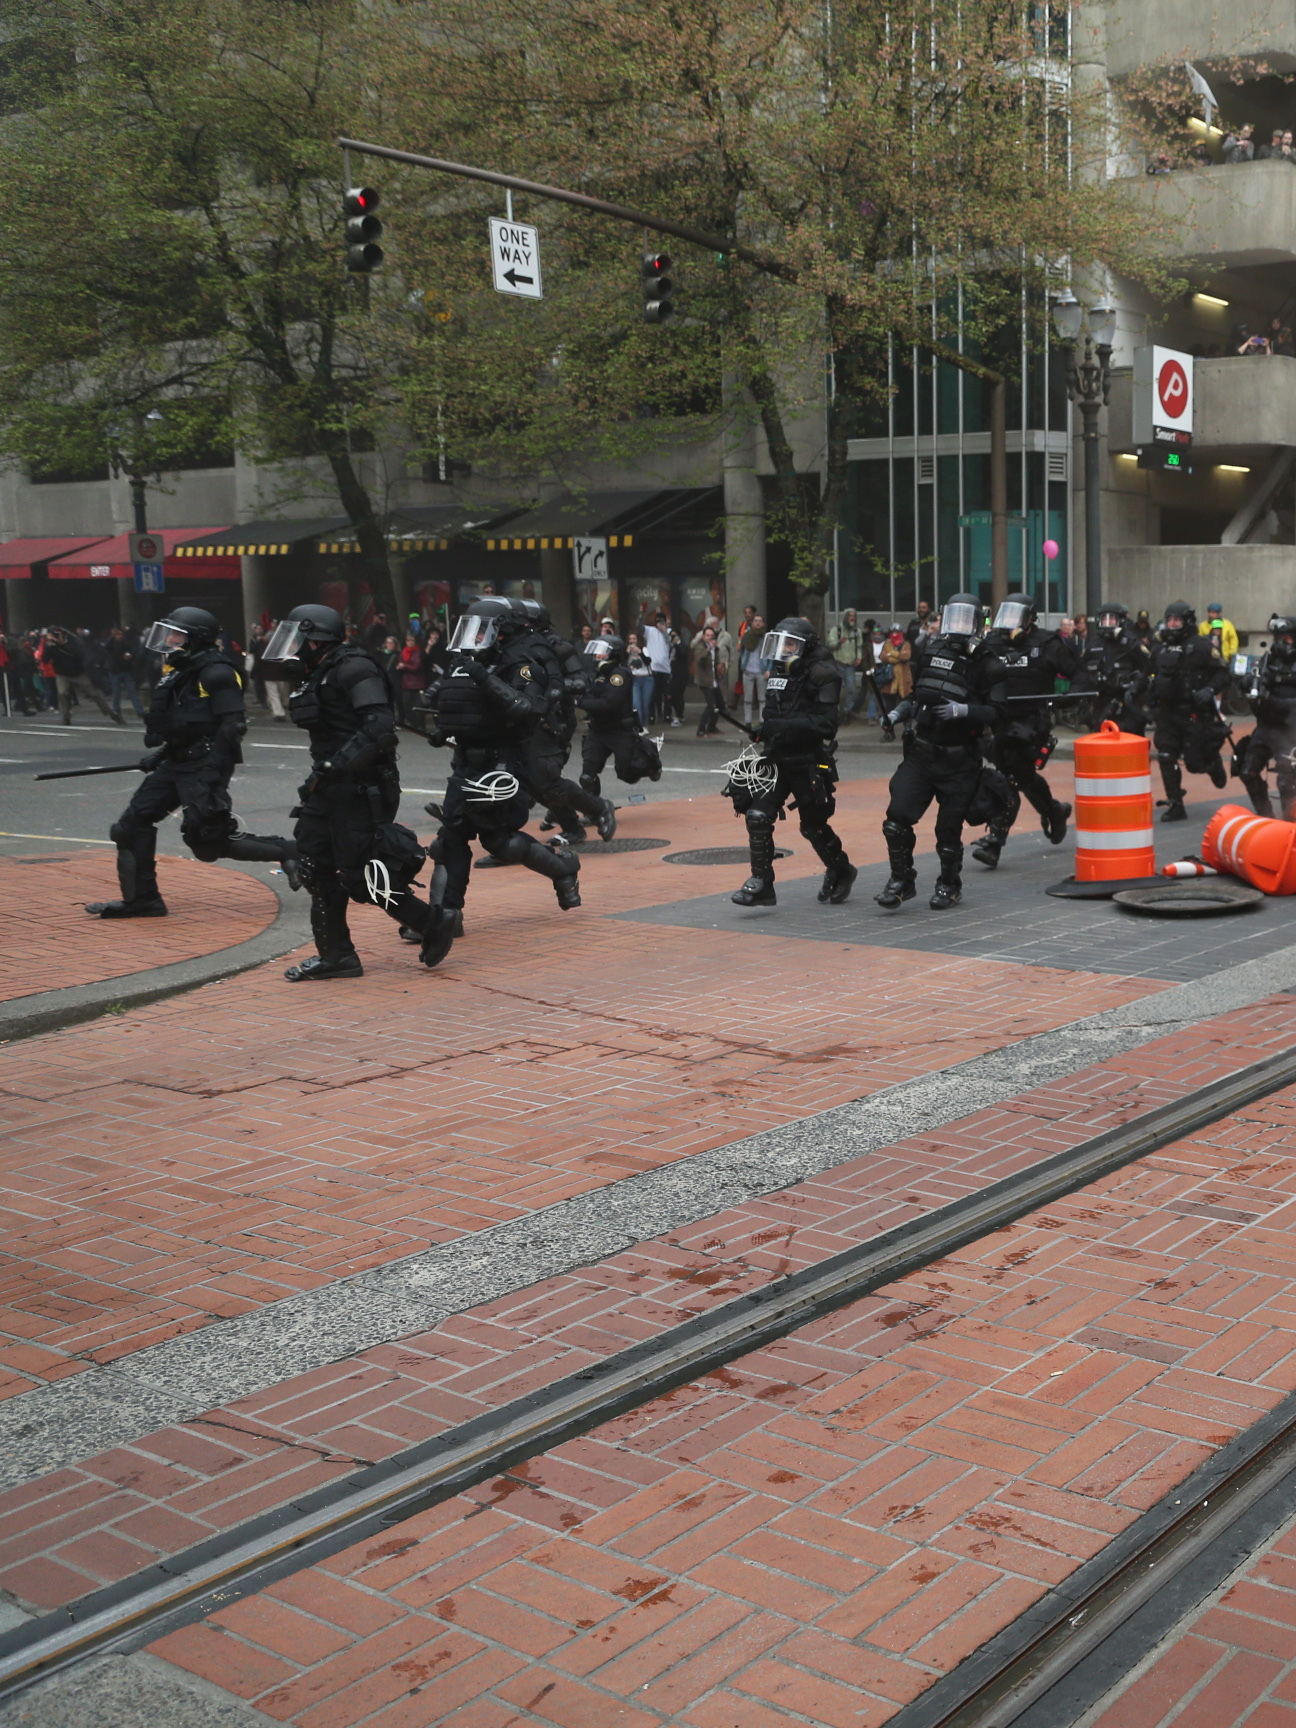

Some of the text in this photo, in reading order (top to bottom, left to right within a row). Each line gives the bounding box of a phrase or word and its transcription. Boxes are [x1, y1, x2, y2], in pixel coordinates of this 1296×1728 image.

[499, 226, 530, 247] ONE
[499, 245, 532, 266] WAY
[1163, 371, 1184, 402] P
[932, 658, 953, 669] POLICE
